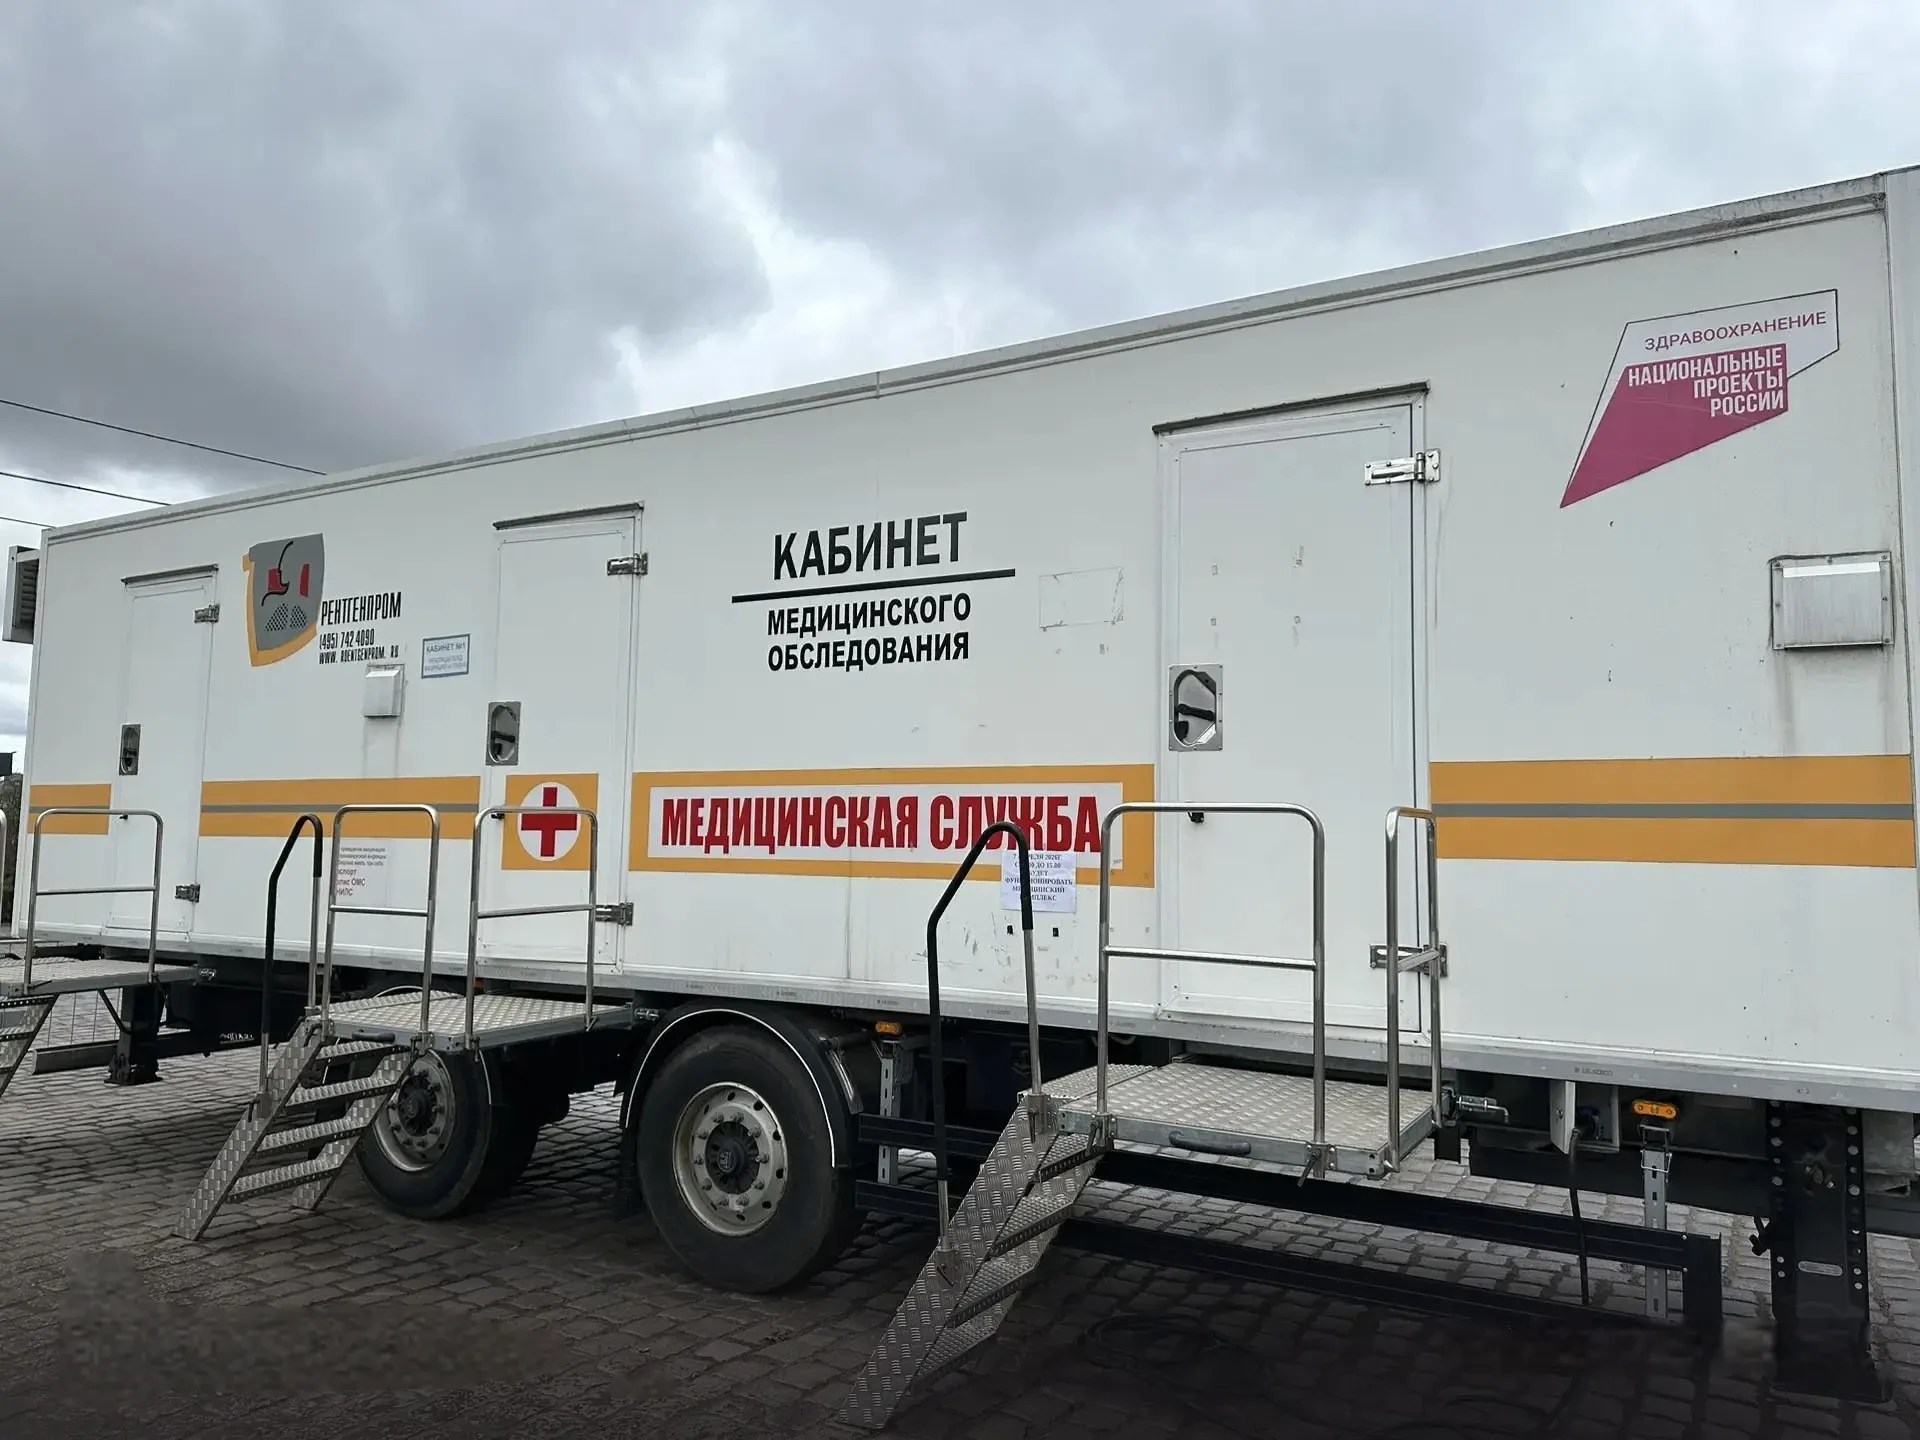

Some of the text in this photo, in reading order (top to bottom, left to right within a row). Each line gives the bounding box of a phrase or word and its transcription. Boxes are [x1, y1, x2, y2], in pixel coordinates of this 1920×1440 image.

[1644, 311, 1827, 352] ЗДРАВООХРАНЕНИЕ
[1628, 346, 1783, 387] НАЦИОНАЛЬНЫЕ
[1693, 370, 1784, 399] ПРОЕКТЫ
[1710, 390, 1784, 417] РОССИИ
[774, 511, 967, 580] КАБИНЕТ
[321, 591, 401, 626] РЕНТГЕНПРОМ
[768, 593, 971, 638] МЕДИЦИНСКОГО
[319, 628, 375, 650] (495) 742 4090
[768, 631, 969, 672] ОБСЛЕДОВАНИЯ
[661, 795, 1101, 854] МЕДИЦИНСКАЯ СЛУЖБА
[336, 887, 353, 896] НИЛС
[351, 878, 366, 887] ОМС
[1012, 886, 1065, 894] МЕЦИНСКИЙ
